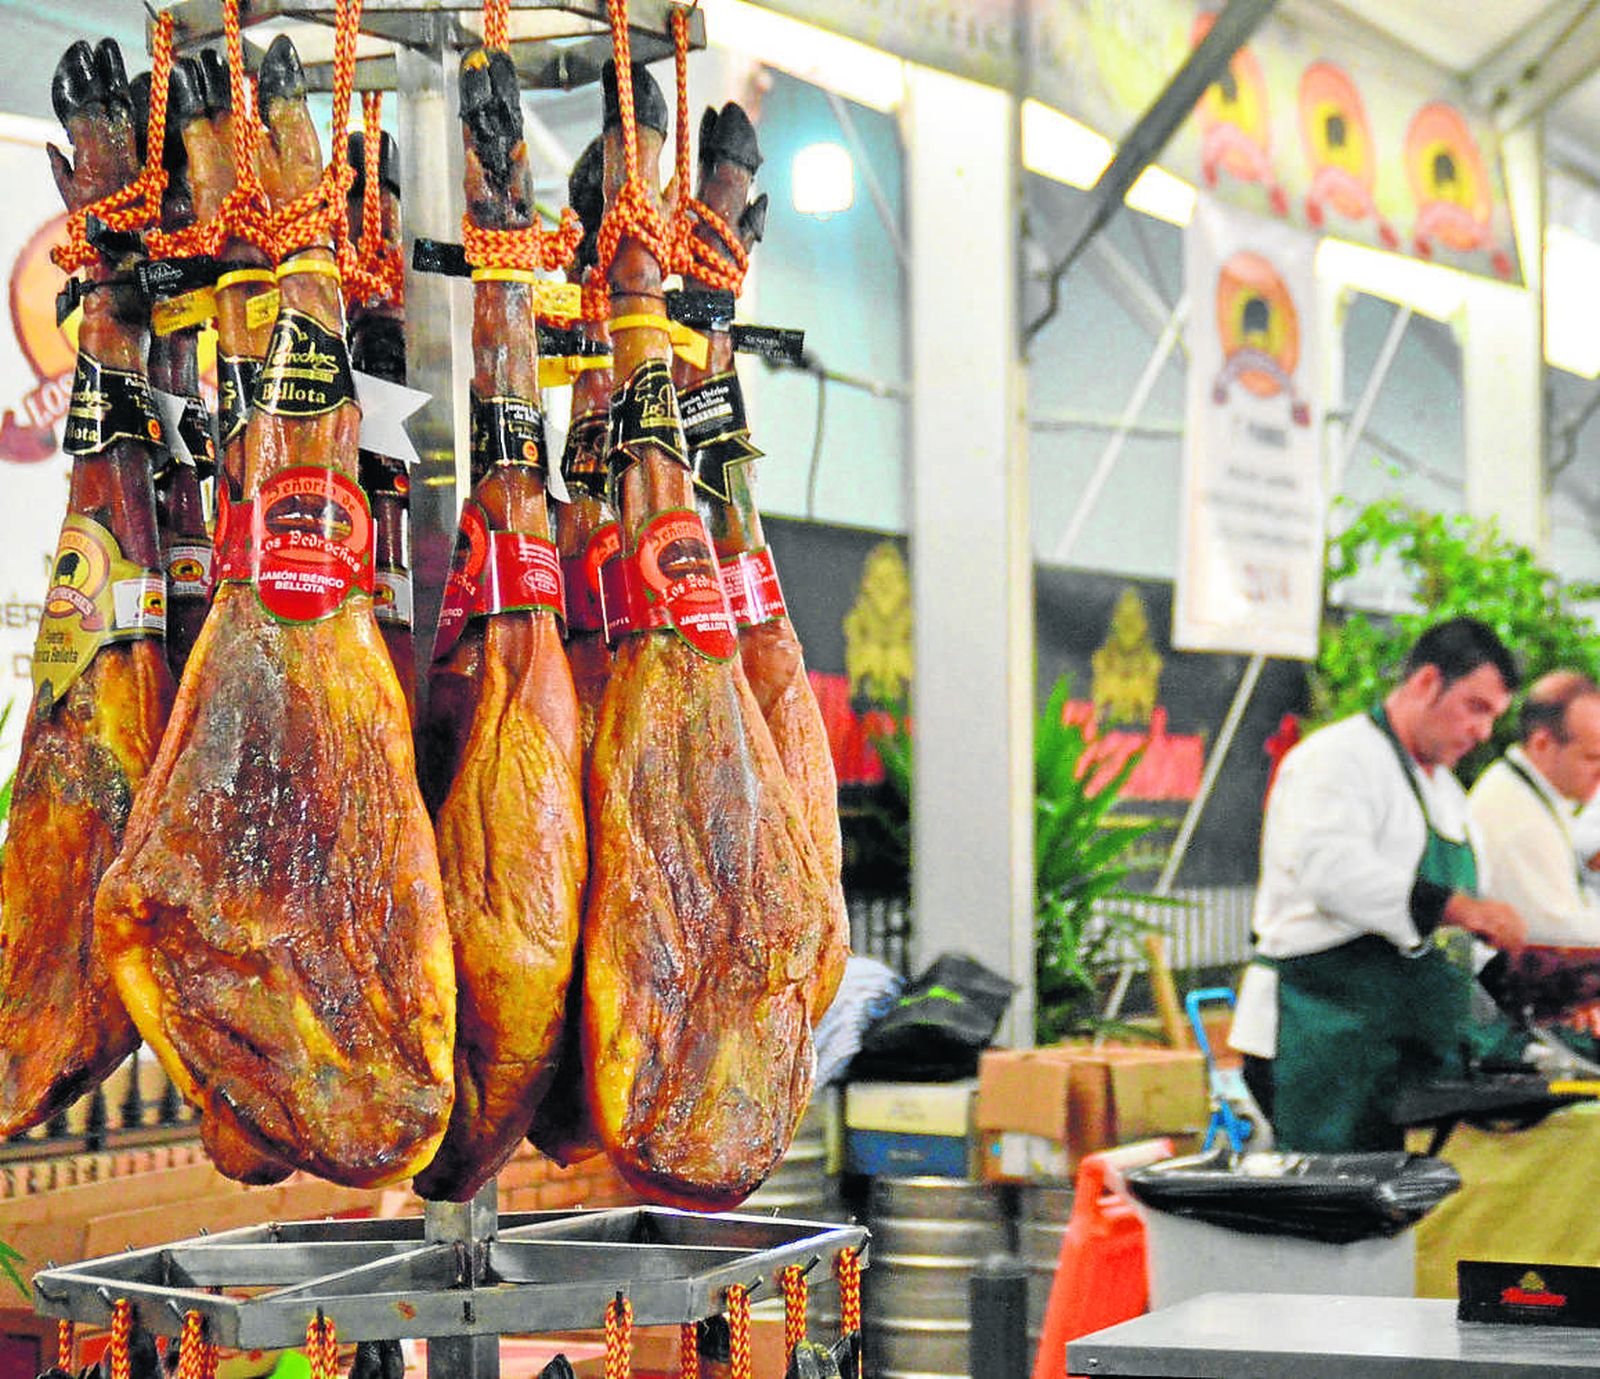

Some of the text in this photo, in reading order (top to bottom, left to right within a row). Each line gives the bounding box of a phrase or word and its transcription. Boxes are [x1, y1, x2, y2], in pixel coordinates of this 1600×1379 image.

[259, 570, 298, 582] JAMÓN
[298, 571, 345, 589] IBÉRICO
[274, 581, 326, 595] BELLOTA
